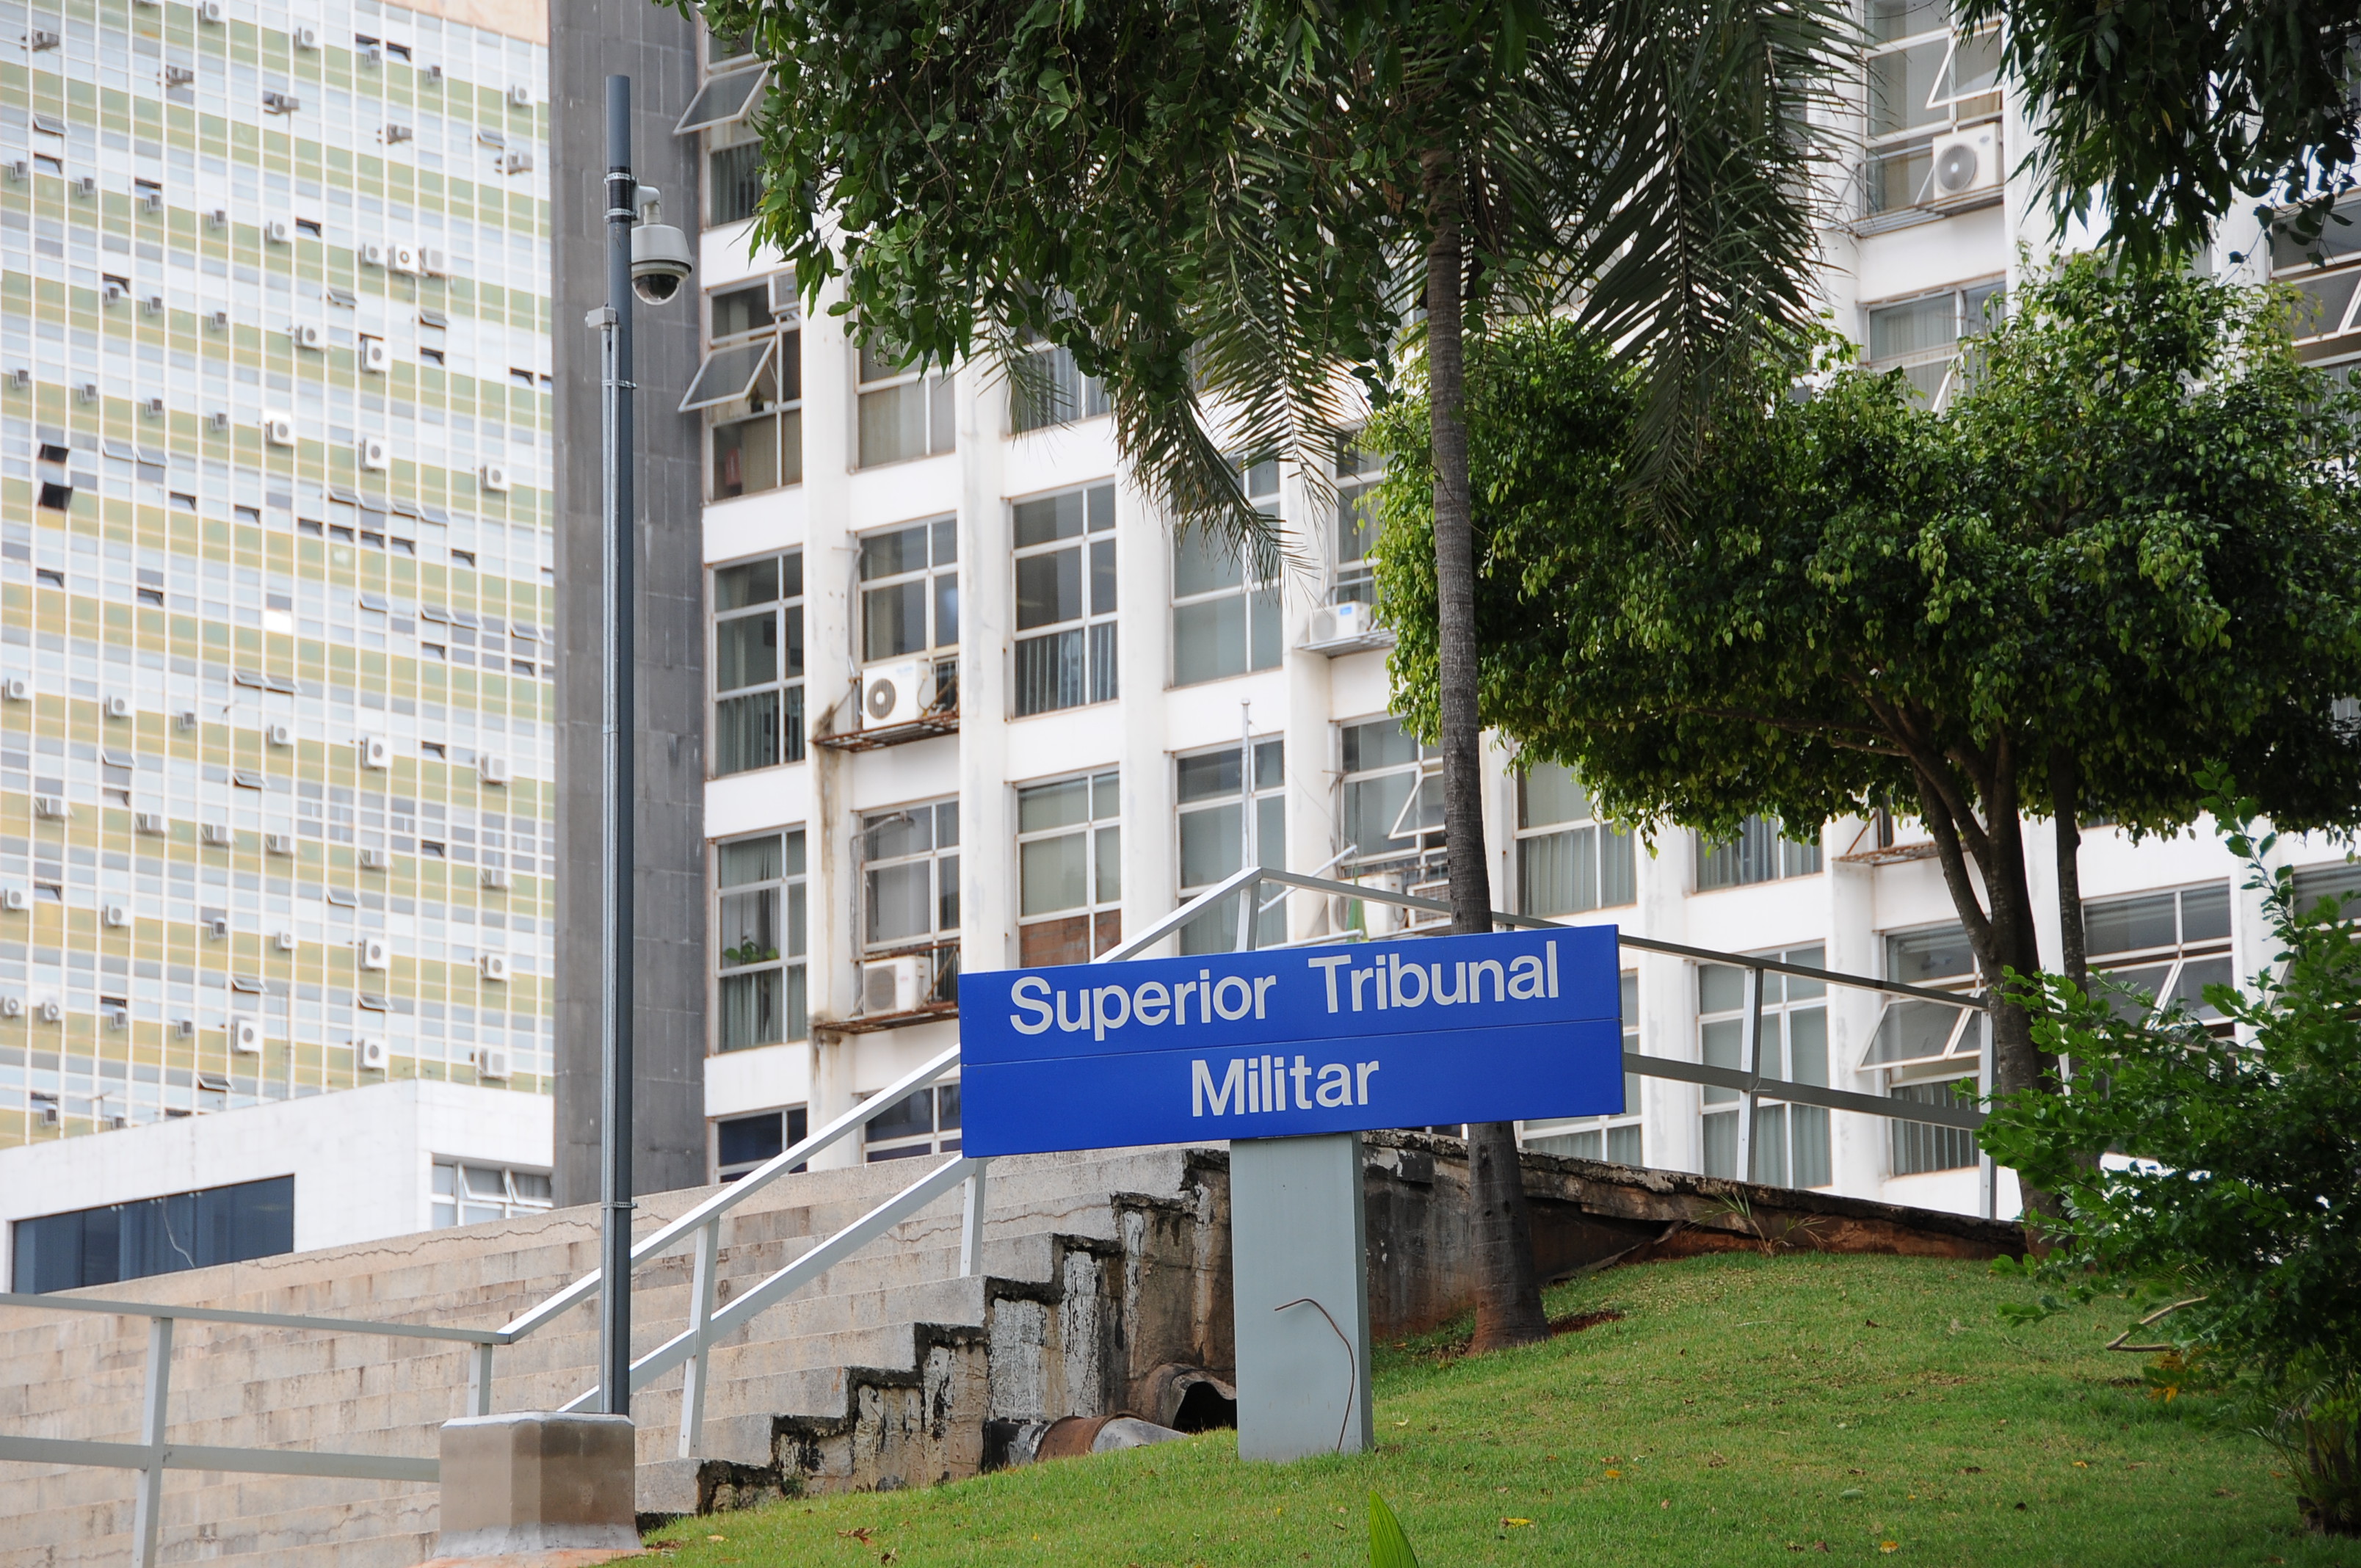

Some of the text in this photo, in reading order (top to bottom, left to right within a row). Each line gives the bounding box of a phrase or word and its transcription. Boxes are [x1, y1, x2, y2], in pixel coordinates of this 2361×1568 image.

[1009, 940, 1559, 1042] Superior Tribunal
[1192, 1054, 1379, 1117] Militar
